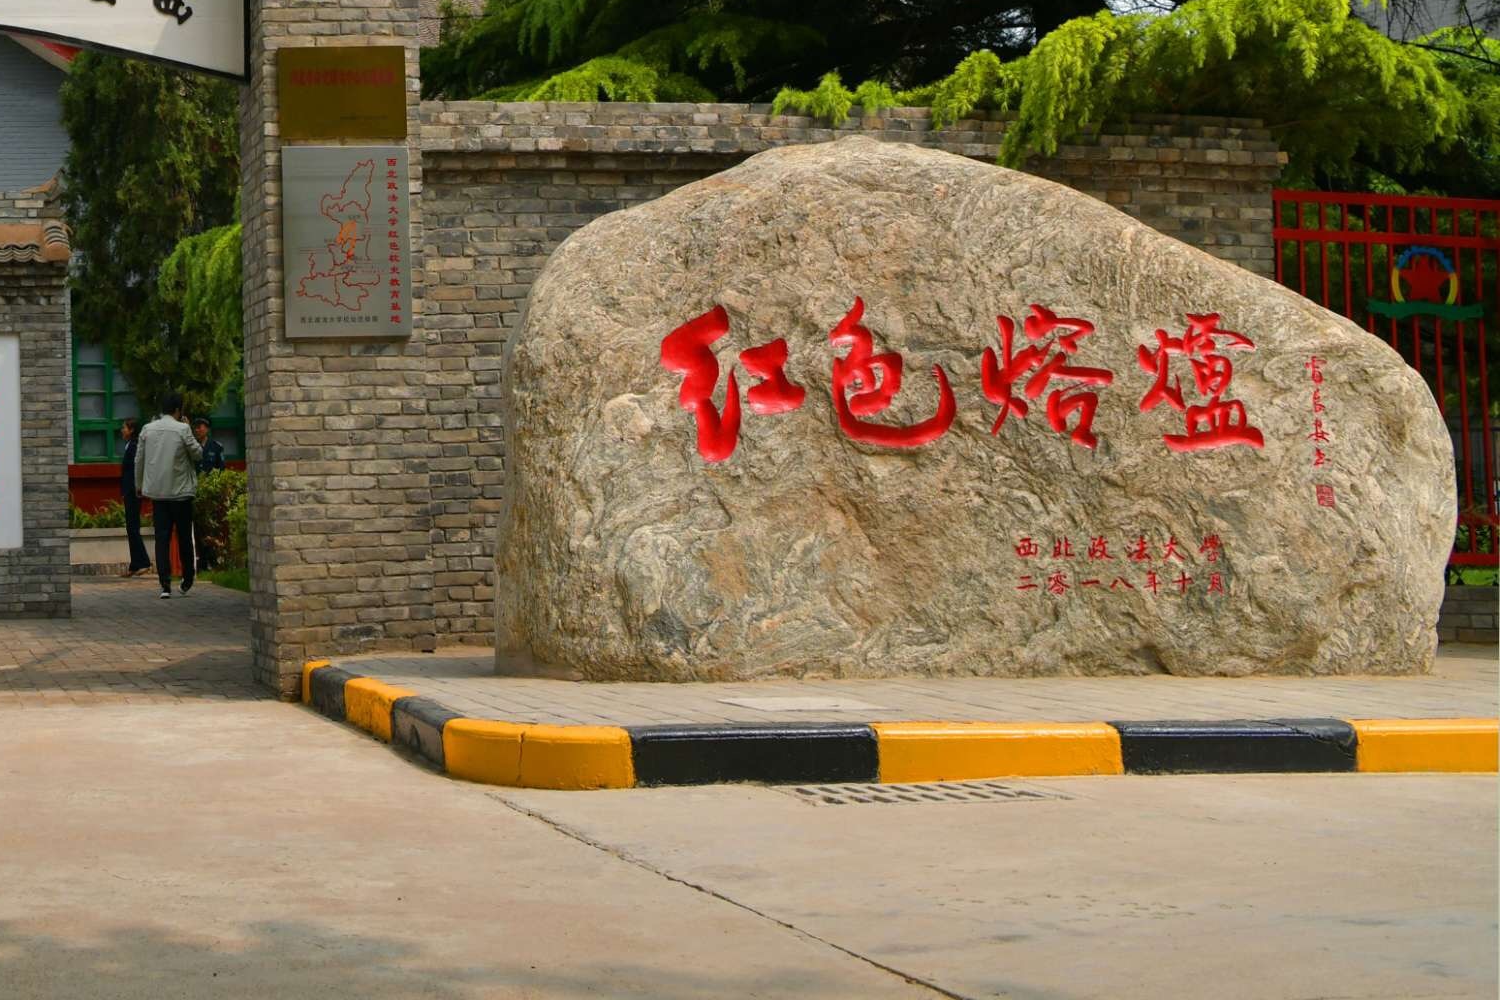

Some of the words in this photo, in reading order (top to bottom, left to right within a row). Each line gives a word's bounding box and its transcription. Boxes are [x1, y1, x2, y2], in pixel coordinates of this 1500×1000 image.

[1015, 570, 1226, 597] 二零一八年十月
